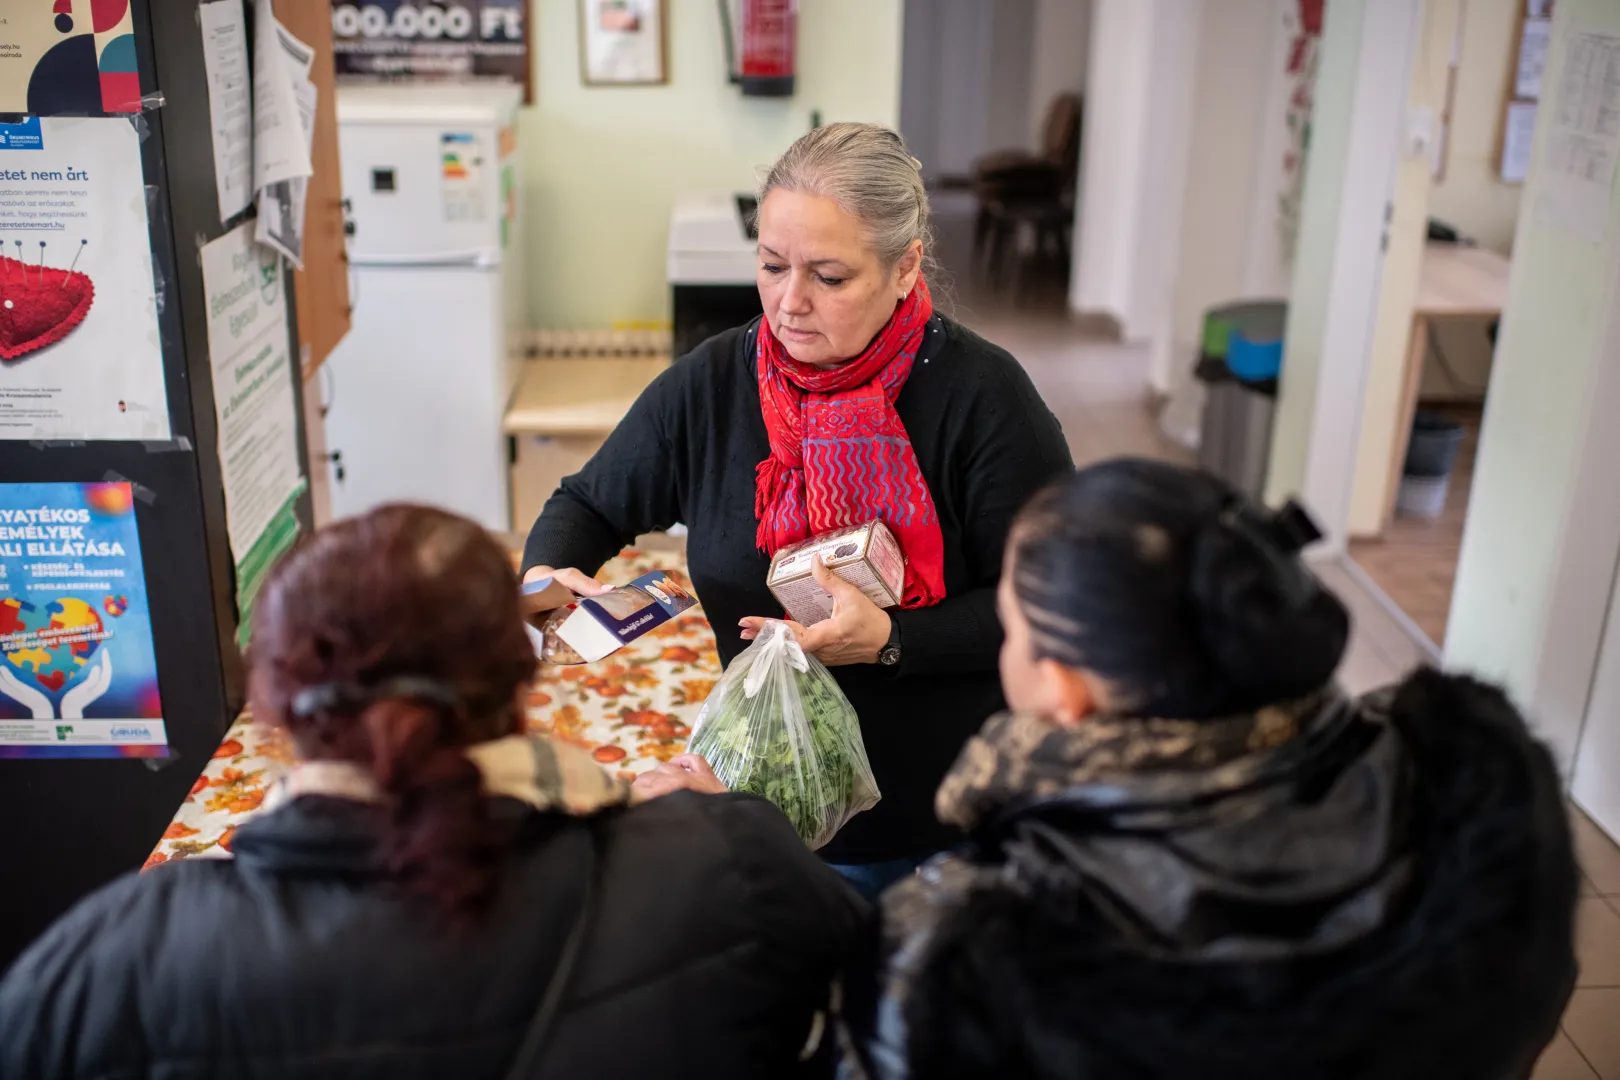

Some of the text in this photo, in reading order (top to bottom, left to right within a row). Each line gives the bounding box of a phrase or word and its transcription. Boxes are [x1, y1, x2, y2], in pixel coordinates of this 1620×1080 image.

[479, 6, 522, 39] Ft
[31, 171, 62, 181] nem
[0, 506, 90, 523] YATÉKOS
[27, 539, 125, 556] ELLÁTÁSA
